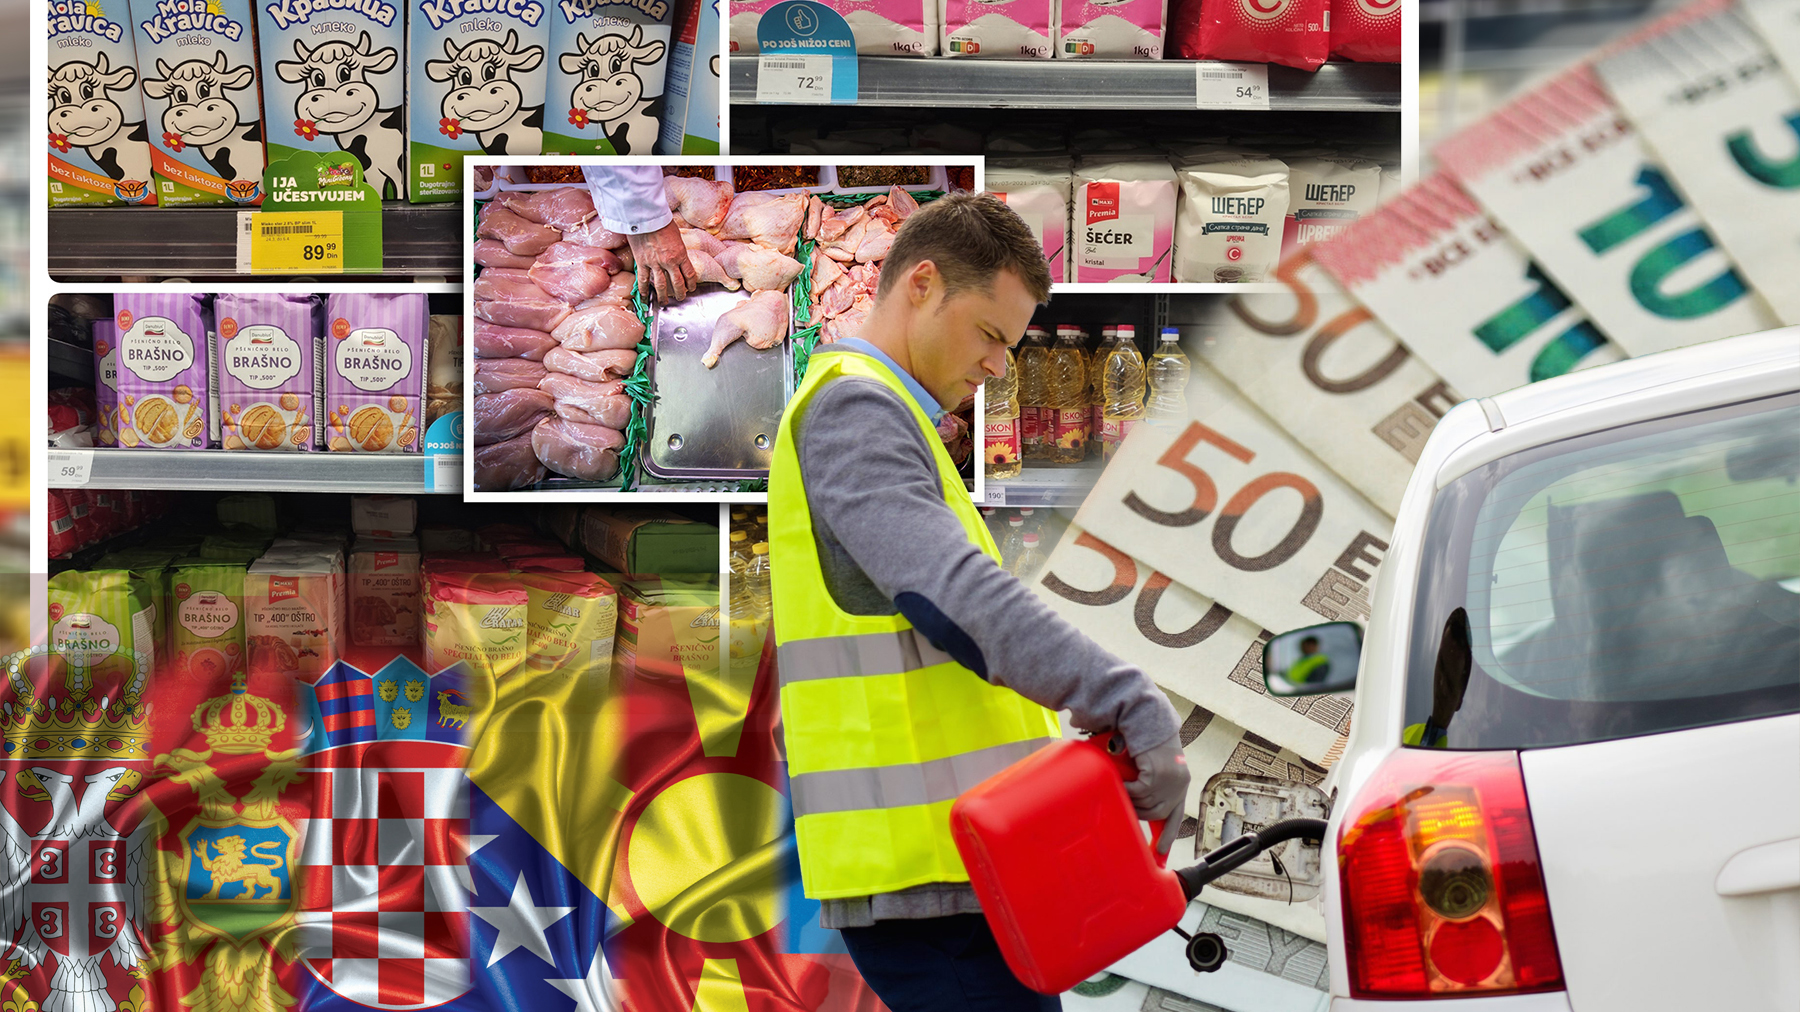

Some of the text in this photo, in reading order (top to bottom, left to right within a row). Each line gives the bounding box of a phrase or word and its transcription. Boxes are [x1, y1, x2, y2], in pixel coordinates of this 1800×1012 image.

[48, 14, 123, 43] ravica
[310, 22, 356, 35] млеко
[460, 18, 502, 33] mleko
[593, 16, 631, 29] млеко
[141, 14, 243, 44] Kravica
[57, 36, 92, 48] mleko
[176, 34, 211, 47] mleko
[762, 38, 851, 48] PO JOŠ NIŽOJ CENI
[893, 42, 911, 53] 1kg
[1020, 46, 1037, 57] 1kg
[1134, 46, 1149, 57] 1kg
[797, 77, 814, 88] 72
[1236, 86, 1252, 98] 54
[50, 163, 112, 190] bez laktoze
[163, 162, 223, 190] bez laktoze
[421, 166, 434, 175] 1L
[51, 184, 62, 192] 1L
[163, 183, 174, 191] 1L
[280, 177, 298, 188] JA
[420, 181, 456, 189] Dugotrajno
[273, 188, 365, 202] UČESTVUJEM
[1305, 183, 1356, 202] ШЕЋЕР
[1212, 197, 1265, 215] ШЕЋЕР
[1089, 209, 1116, 218] Premia
[1086, 227, 1133, 244] ŠEĆER
[1576, 159, 1752, 320] 10
[303, 245, 324, 260] 89
[326, 243, 336, 251] 99
[129, 347, 184, 361] BRAŠNO
[233, 354, 292, 368] BRAŠNO
[344, 356, 402, 371] BRAŠNO
[439, 440, 455, 449] JOŠ
[61, 467, 75, 476] 59
[1121, 420, 1324, 572] 50
[377, 558, 396, 566] Premia
[391, 577, 411, 587] OŠTRO
[271, 589, 296, 598] Premia
[184, 613, 231, 623] BRAŠNO
[254, 613, 265, 623] TIP
[291, 611, 316, 623] OŠTRO
[57, 638, 111, 650] BRAŠNO
[454, 643, 487, 652] PŠENIČNO
[553, 638, 577, 649] BELO
[670, 643, 715, 652] PŠENIČNO
[443, 647, 522, 661] SPECIJALNO BELO
[673, 653, 709, 662] BRAŠNO
